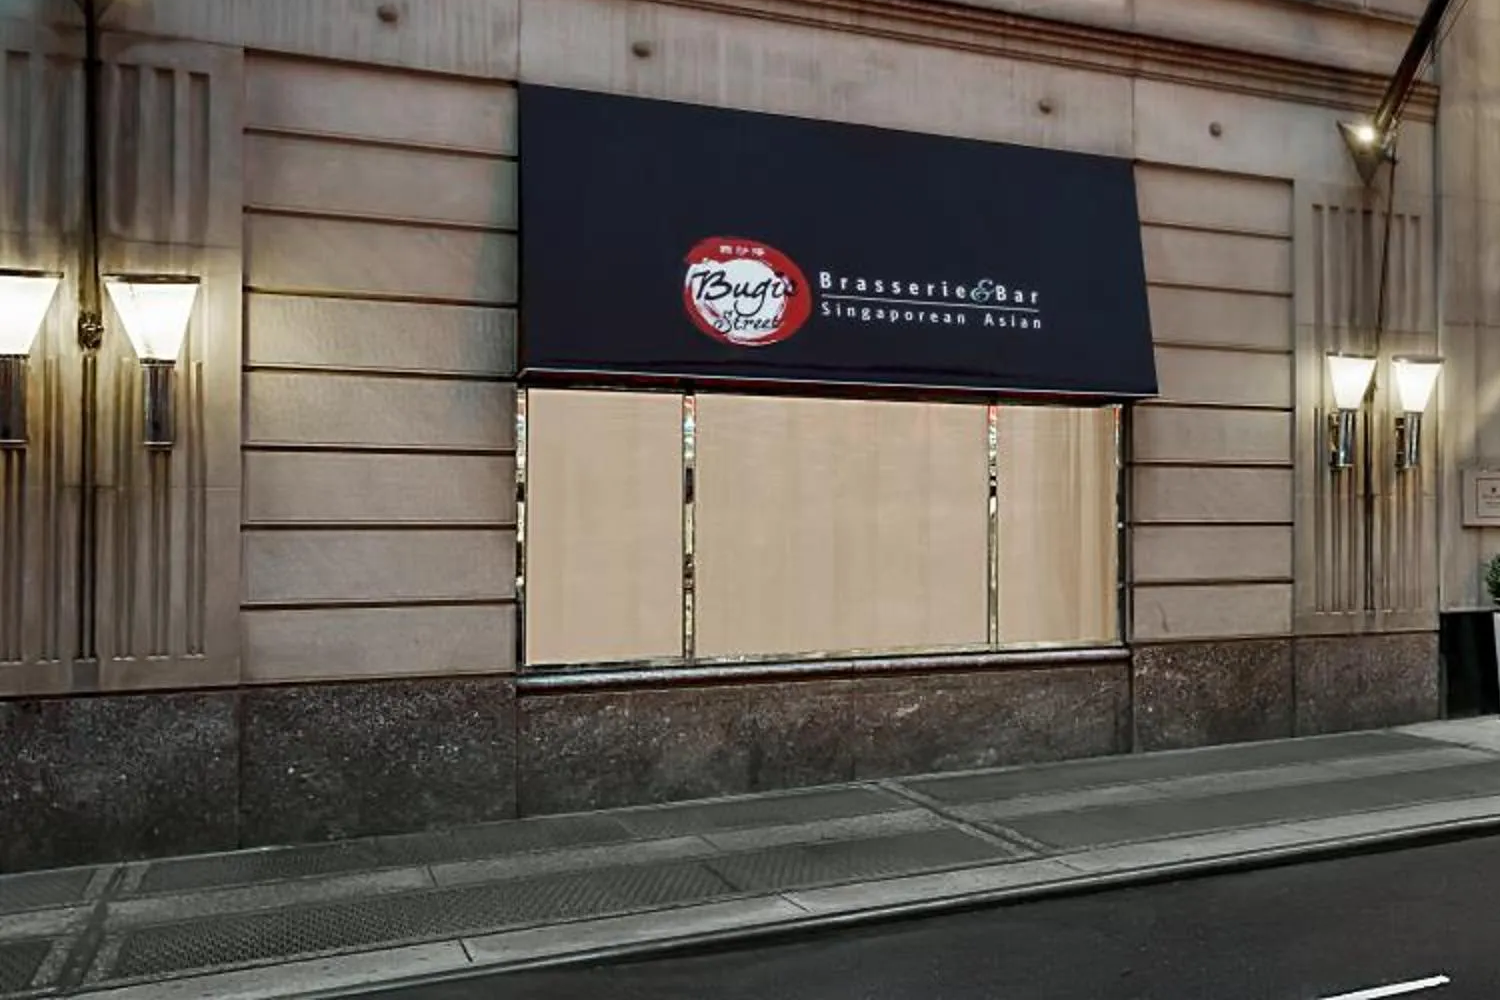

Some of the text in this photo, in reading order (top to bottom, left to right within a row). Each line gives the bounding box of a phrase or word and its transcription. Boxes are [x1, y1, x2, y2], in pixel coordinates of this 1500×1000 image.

[713, 309, 781, 334] Street
[821, 301, 1042, 330] Singaporean Asian
